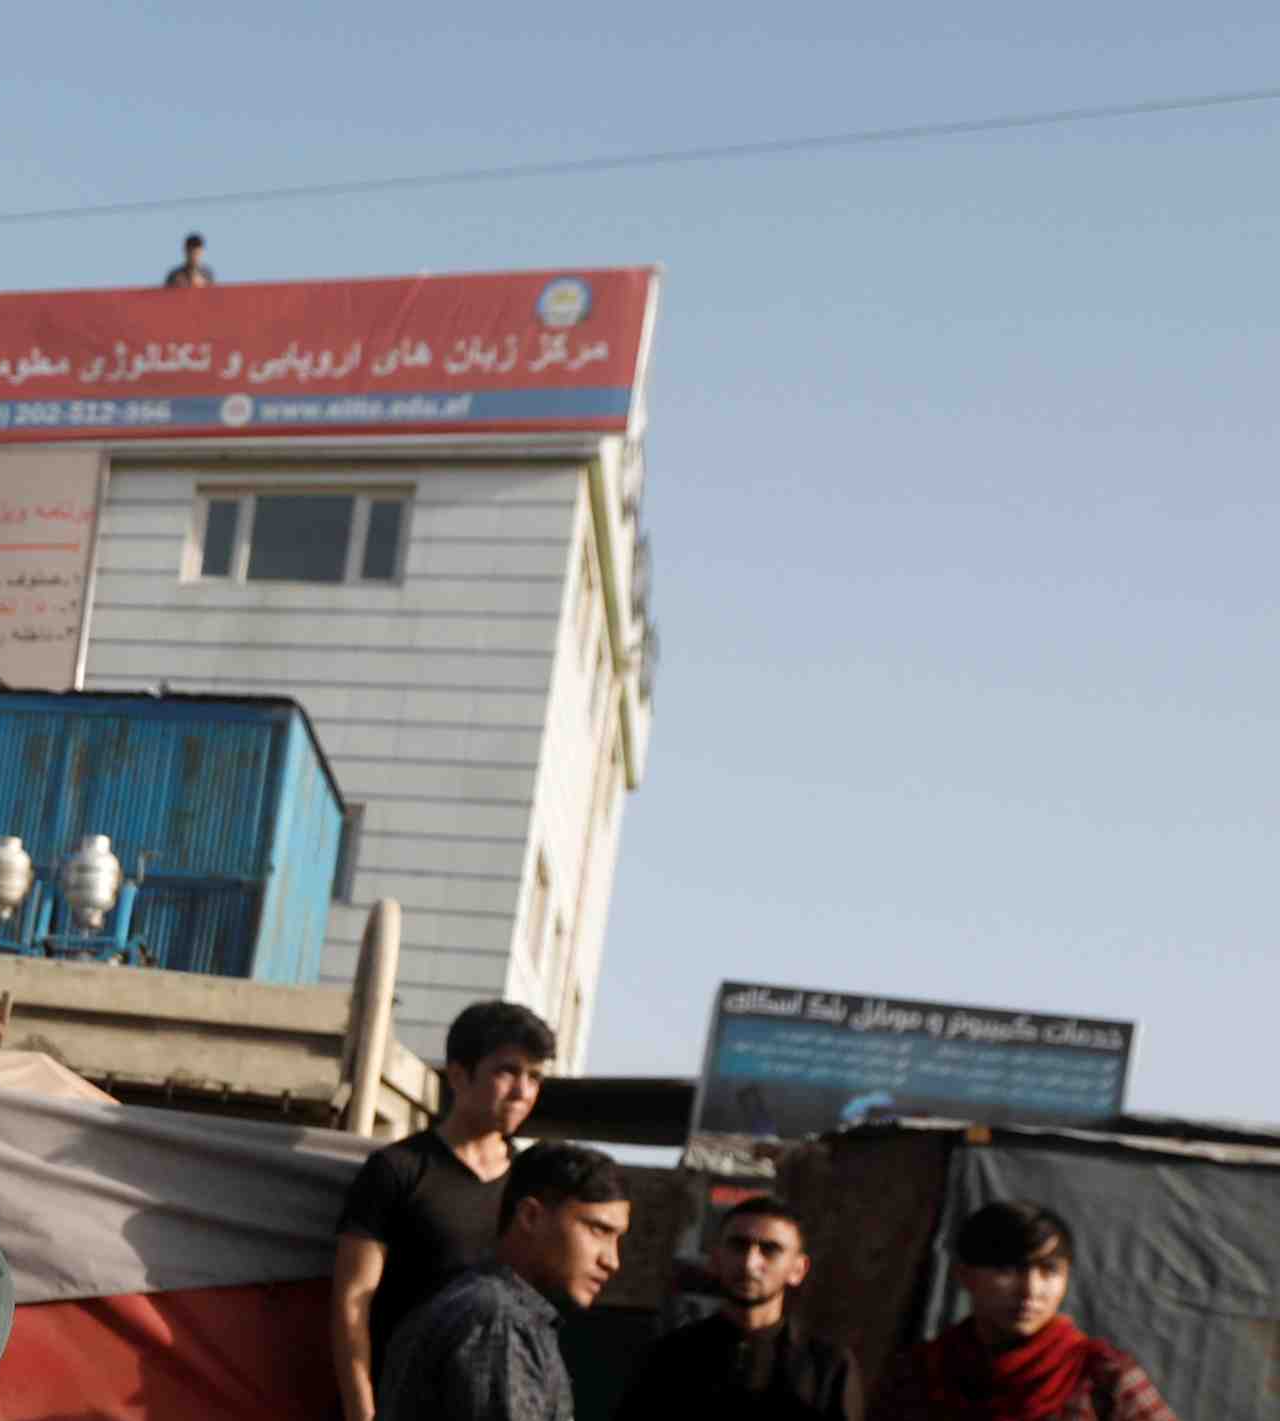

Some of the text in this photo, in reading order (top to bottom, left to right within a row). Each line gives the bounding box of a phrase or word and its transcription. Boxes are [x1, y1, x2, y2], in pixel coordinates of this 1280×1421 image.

[220, 350, 244, 379] و
[371, 337, 433, 376] های
[444, 334, 519, 375] زبان
[527, 334, 609, 372] مرکز
[924, 1009, 944, 1038] و
[1044, 1021, 1125, 1052] خدمات
